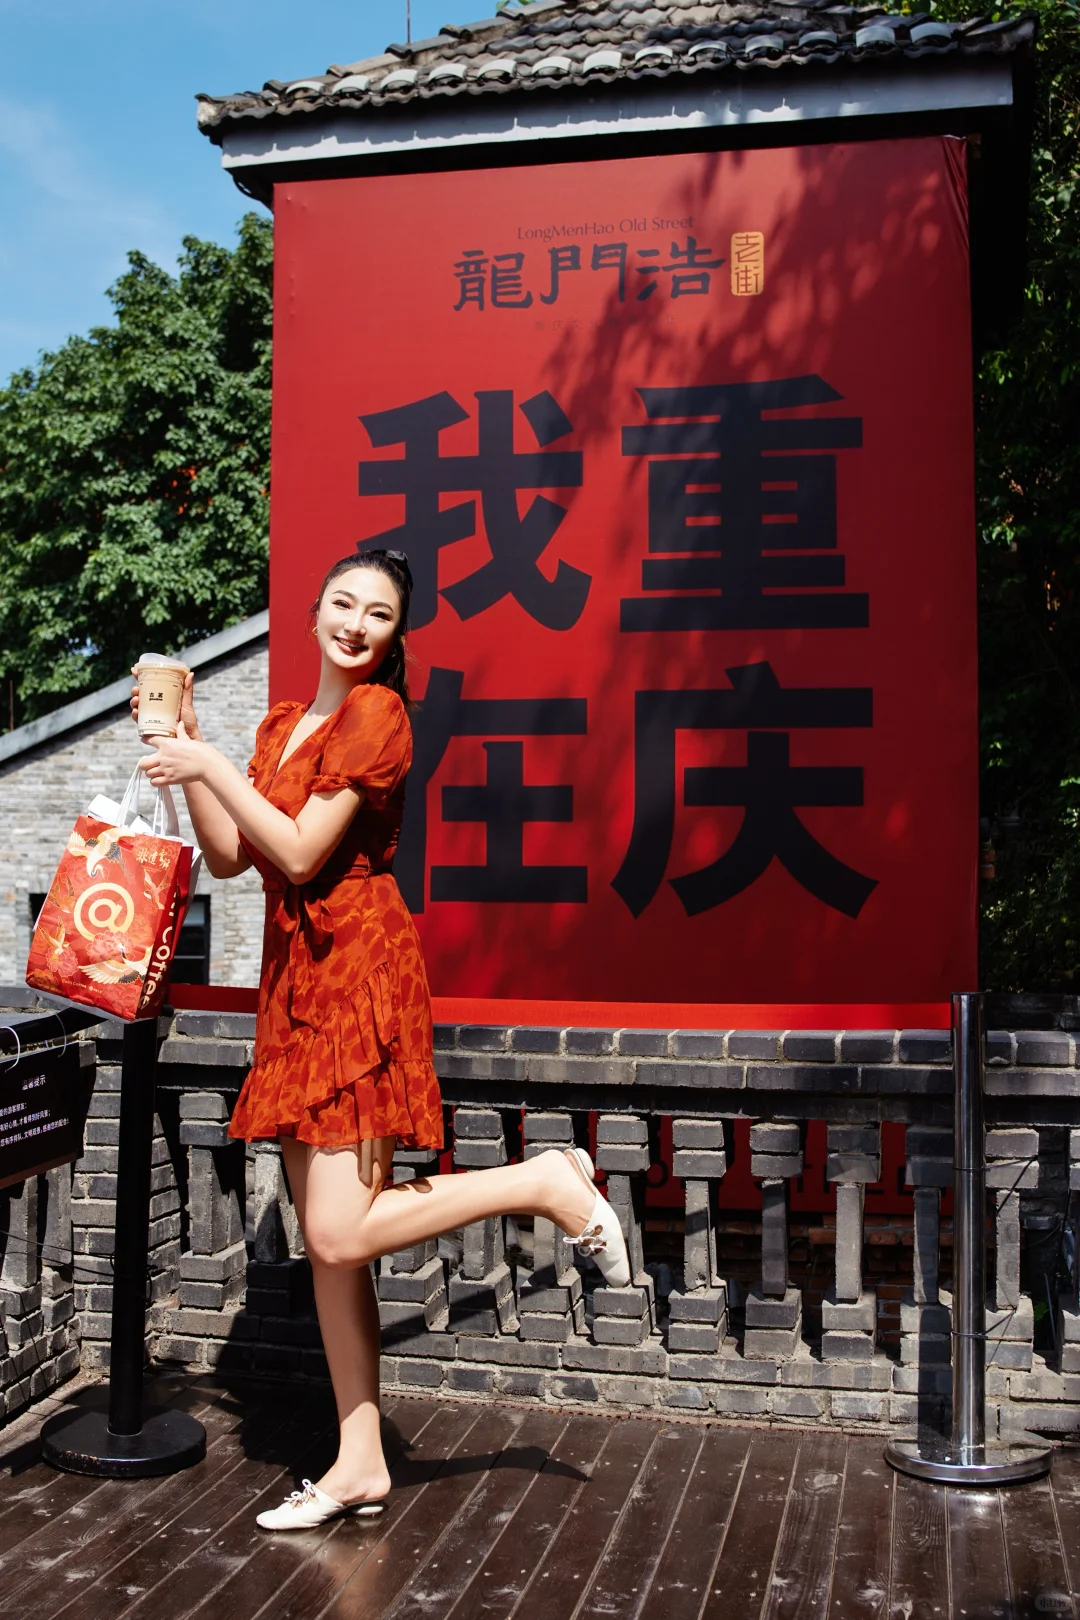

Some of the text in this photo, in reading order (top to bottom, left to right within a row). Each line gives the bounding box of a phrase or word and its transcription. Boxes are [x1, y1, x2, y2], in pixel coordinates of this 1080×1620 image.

[517, 215, 694, 242] LongMenHao Old Street
[453, 236, 726, 311] 龍門浩
[734, 234, 760, 294] 老街
